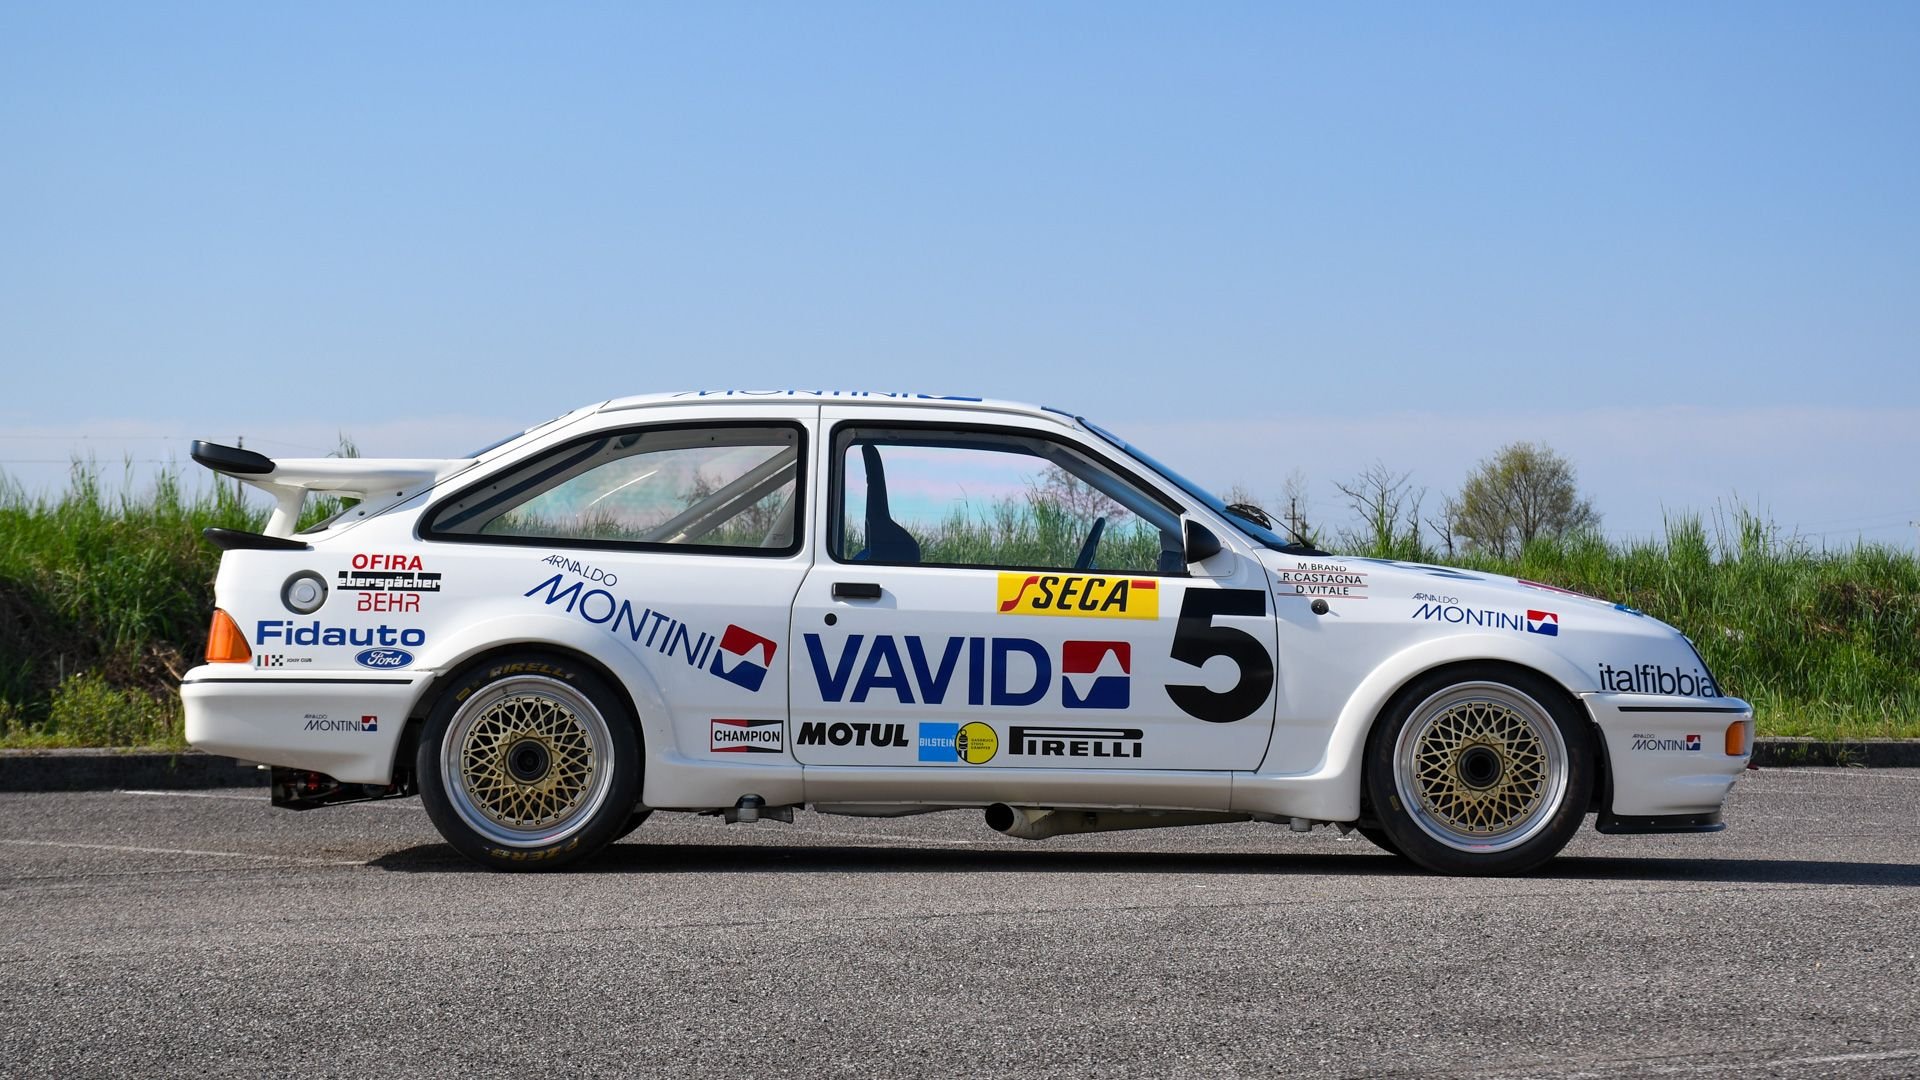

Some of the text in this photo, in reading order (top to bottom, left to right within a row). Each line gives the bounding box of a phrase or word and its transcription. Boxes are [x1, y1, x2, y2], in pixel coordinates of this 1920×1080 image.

[352, 554, 423, 570] OFIRA
[541, 554, 617, 587] ARNALDO
[1297, 562, 1347, 572] M.BRAND
[338, 571, 441, 591] eberspächer
[1283, 572, 1362, 584] R.CASTAGNA
[1295, 585, 1349, 595] D.VITALE
[1412, 592, 1459, 605] ARNALDO
[357, 592, 420, 612] BEHR
[523, 573, 716, 670] MONTINI
[1412, 603, 1523, 631] MONTINI
[256, 620, 426, 647] Fidauto
[368, 650, 402, 666] Ford
[1164, 587, 1274, 723] 5
[803, 633, 1052, 706] VAVID
[1598, 663, 1716, 698] italfibbia
[303, 720, 360, 732] MONTINI
[797, 722, 909, 747] MOTUL
[714, 730, 780, 743] CHAMPION
[919, 737, 955, 747] BILSTEIN
[1008, 725, 1144, 758] PIRELLI
[1631, 739, 1685, 751] MONTINI
